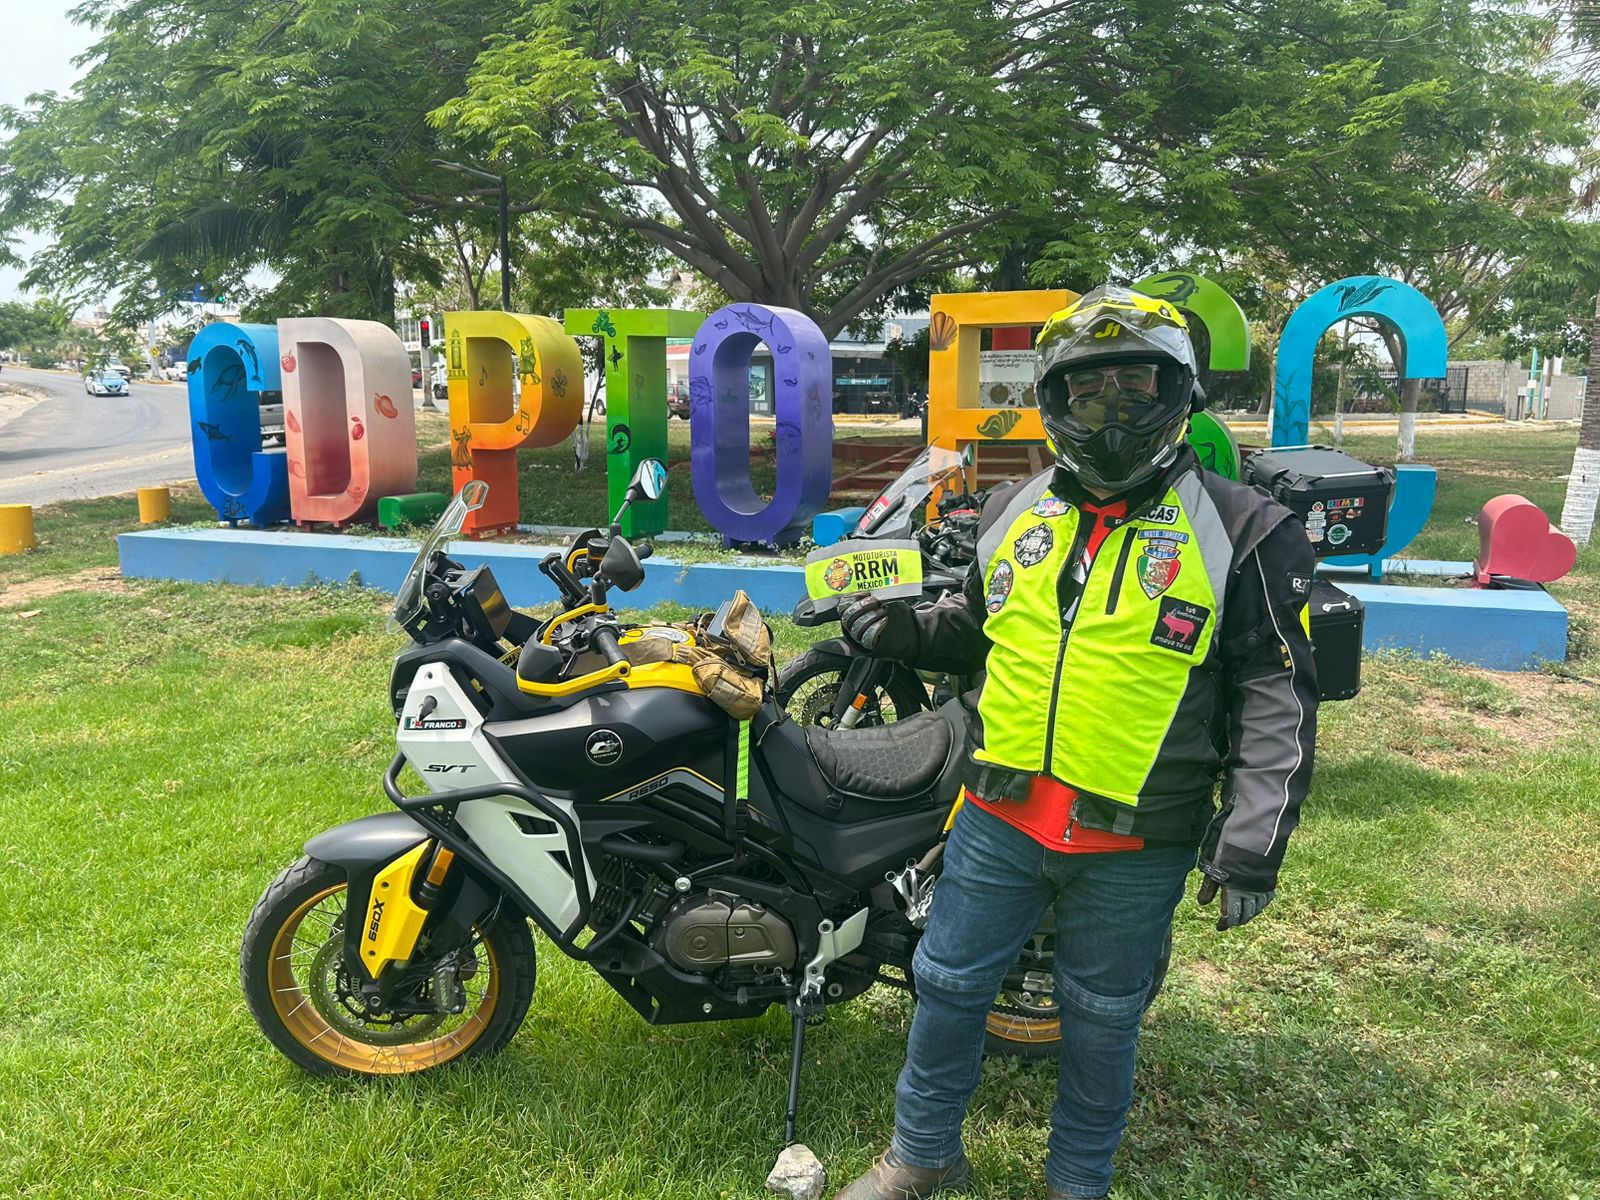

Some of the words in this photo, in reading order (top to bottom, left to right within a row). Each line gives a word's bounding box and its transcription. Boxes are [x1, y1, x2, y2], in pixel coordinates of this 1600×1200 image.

[853, 551, 897, 561] MOTOTURISTA
[854, 558, 899, 581] RRM
[1154, 635, 1176, 647] PROUD
[1175, 641, 1184, 649] TO
[423, 721, 457, 730] FRANCO
[423, 764, 477, 774] SVT
[629, 776, 669, 801] R650
[368, 897, 386, 943] 650X
